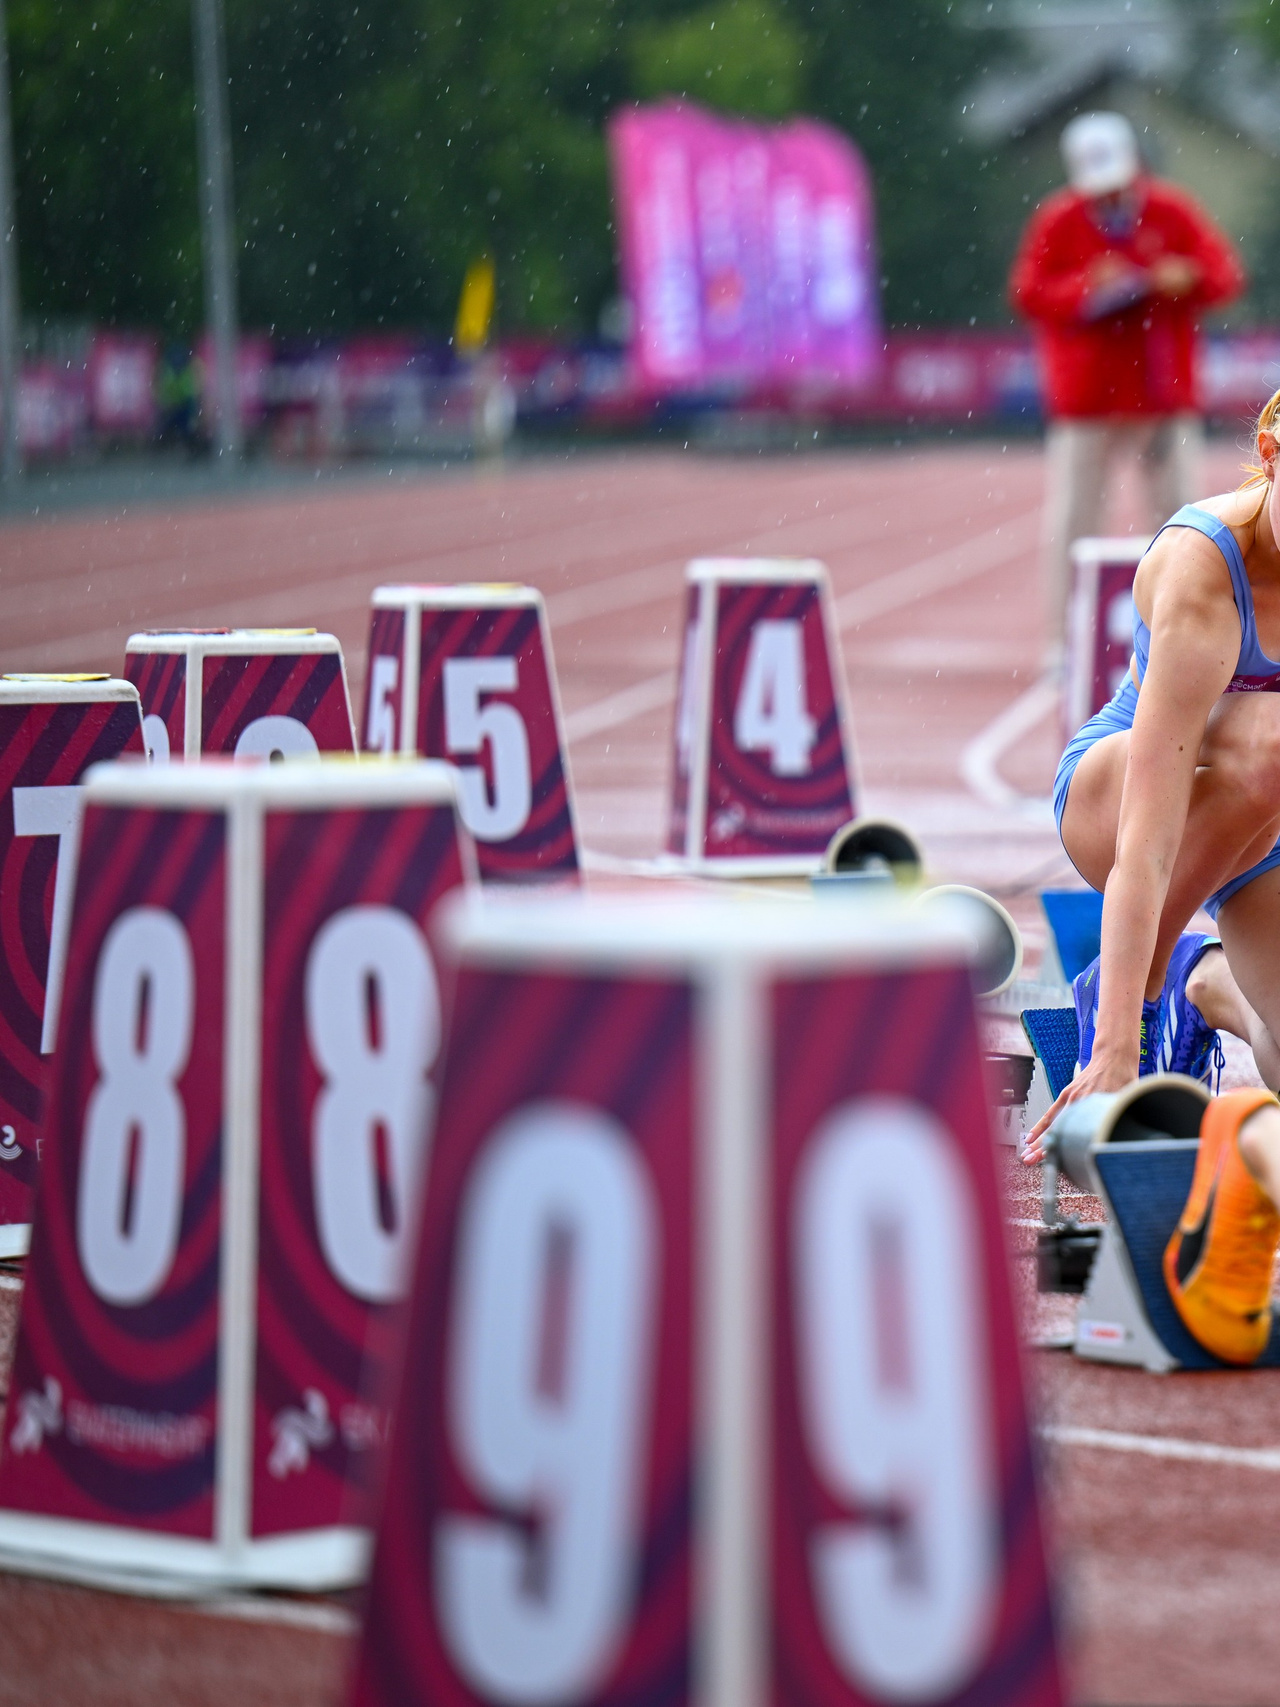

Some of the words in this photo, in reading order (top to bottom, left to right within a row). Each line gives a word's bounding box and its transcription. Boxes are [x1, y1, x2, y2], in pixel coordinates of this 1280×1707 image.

[443, 657, 531, 842] 5
[734, 619, 818, 777] 4
[77, 906, 194, 1305] 8
[306, 905, 441, 1301] 8
[433, 1103, 662, 1705] 9
[793, 1095, 997, 1702] 9
